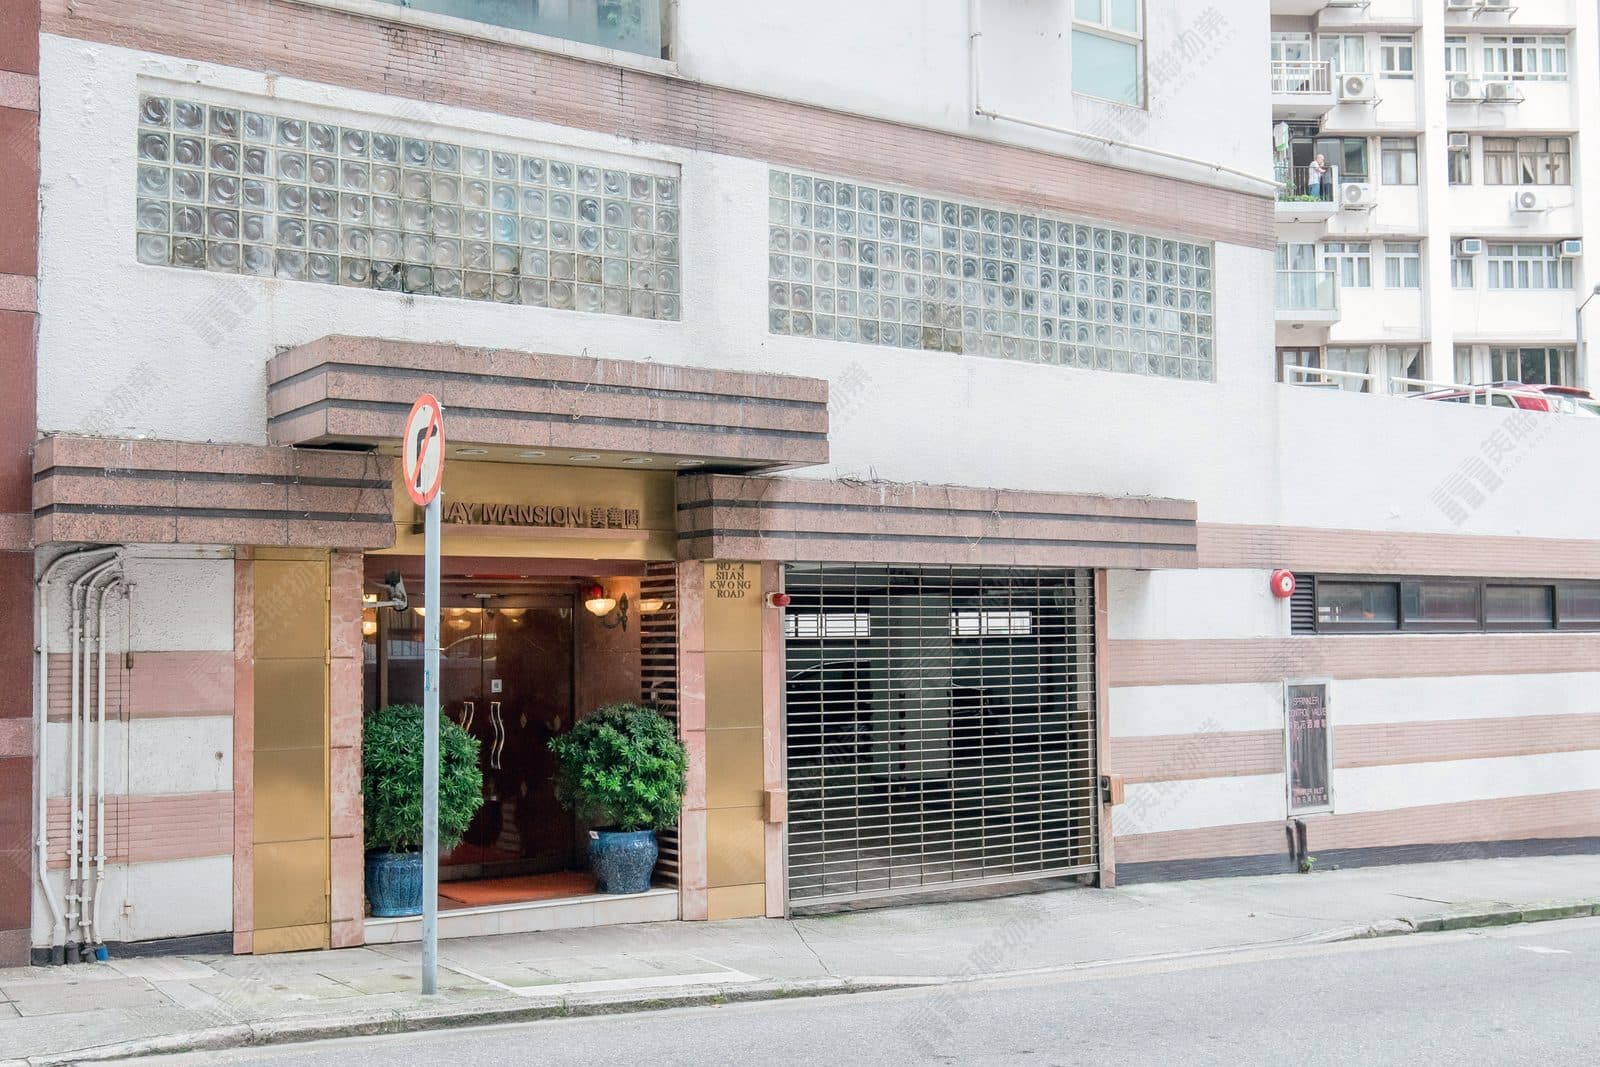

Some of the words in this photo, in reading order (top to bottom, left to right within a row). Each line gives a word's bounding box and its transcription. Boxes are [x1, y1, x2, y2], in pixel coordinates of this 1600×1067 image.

[440, 501, 475, 523] AY
[481, 503, 584, 525] MANSION
[715, 571, 745, 580] SHAN
[709, 580, 752, 590] KWONG
[716, 589, 745, 599] ROAD
